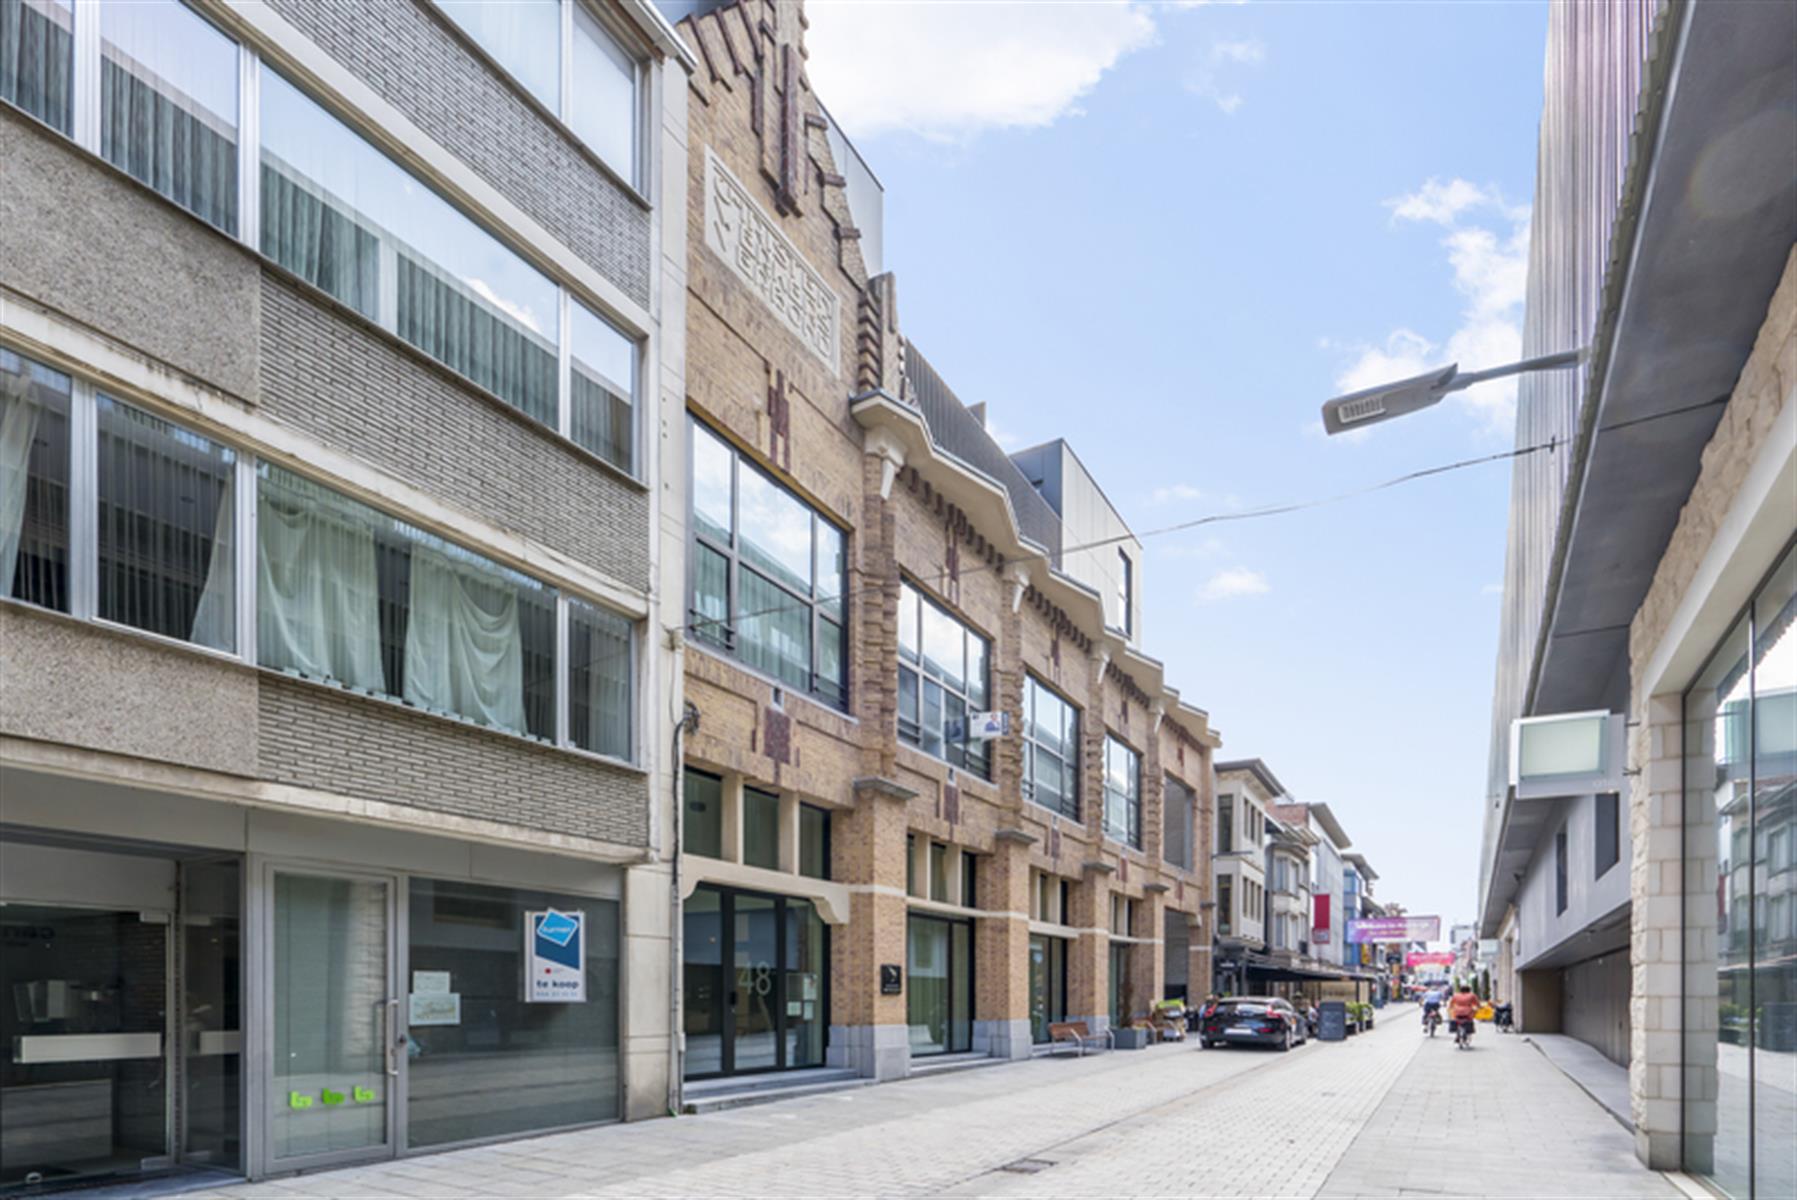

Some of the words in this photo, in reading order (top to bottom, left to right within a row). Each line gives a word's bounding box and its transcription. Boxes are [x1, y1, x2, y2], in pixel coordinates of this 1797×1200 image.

[536, 978, 548, 989] te
[552, 979, 579, 991] koop
[738, 961, 771, 996] 48
